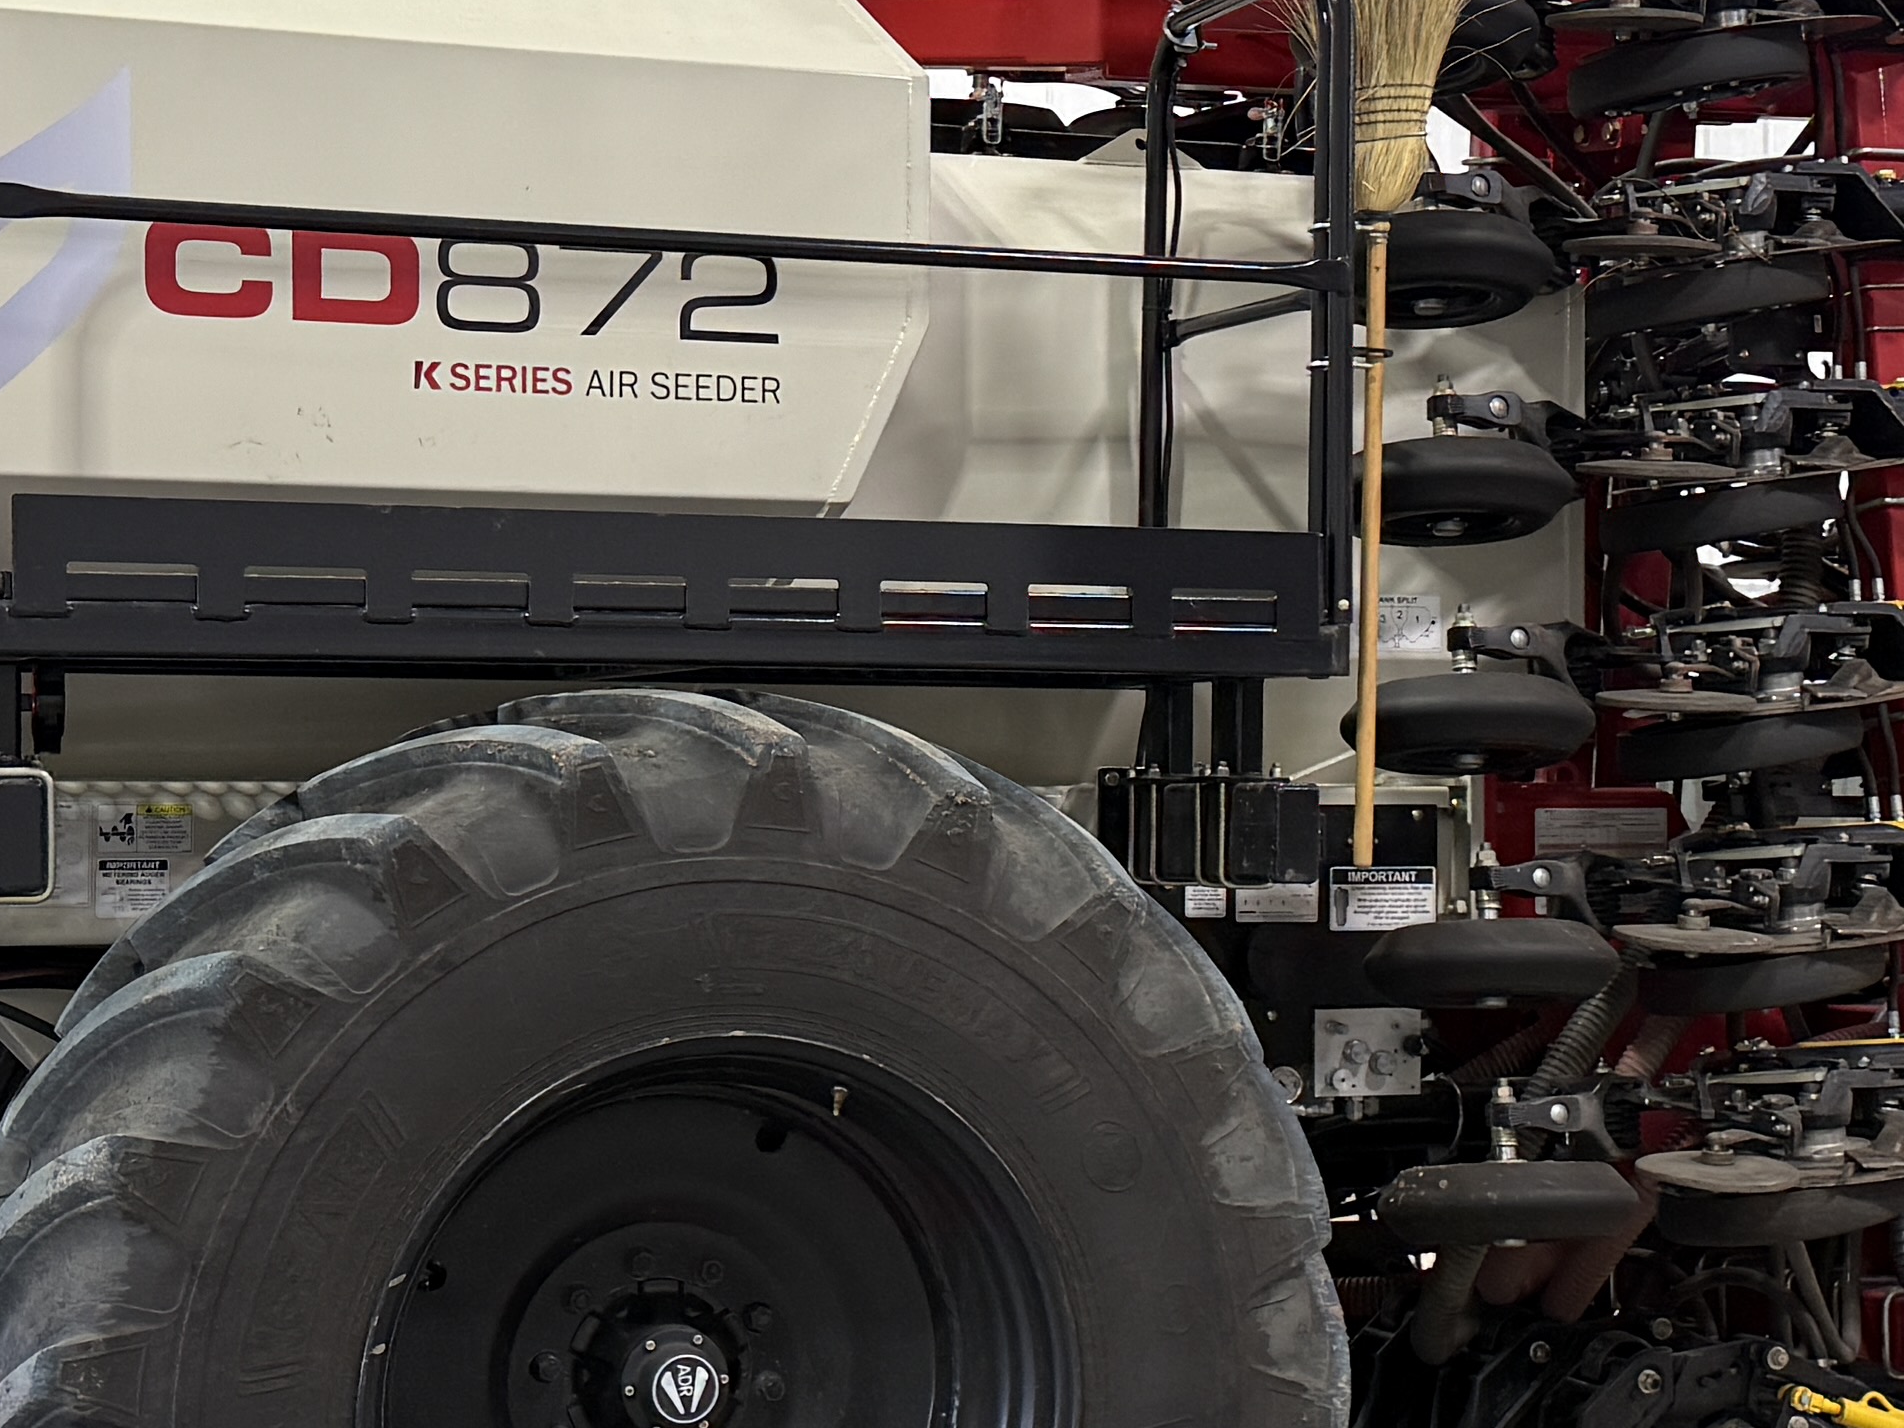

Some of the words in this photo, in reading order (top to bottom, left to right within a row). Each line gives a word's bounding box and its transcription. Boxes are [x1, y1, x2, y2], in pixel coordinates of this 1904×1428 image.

[144, 221, 780, 344] CD872
[413, 360, 442, 390] K
[448, 362, 573, 396] SERIES
[586, 369, 639, 399] AIR
[650, 371, 781, 405] SEEDER
[1396, 610, 1403, 619] 2
[1347, 871, 1417, 882] IMPORTANT
[676, 1364, 694, 1397] ADR
